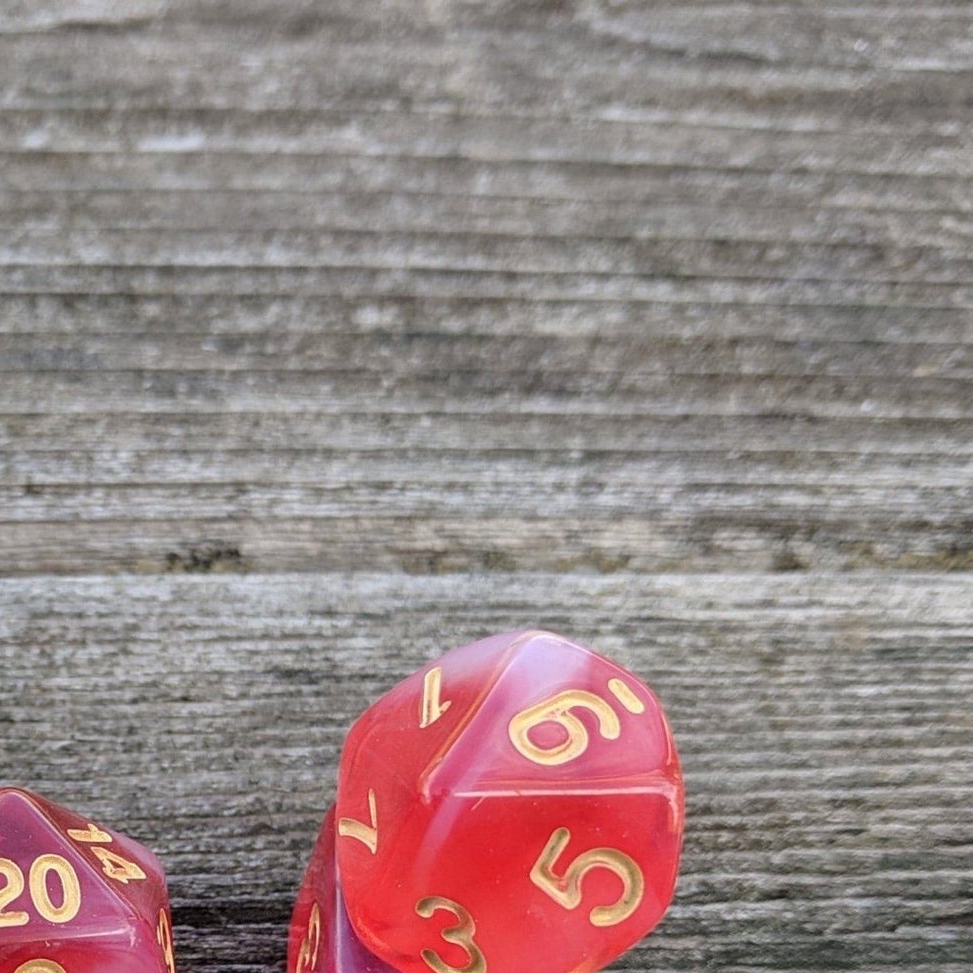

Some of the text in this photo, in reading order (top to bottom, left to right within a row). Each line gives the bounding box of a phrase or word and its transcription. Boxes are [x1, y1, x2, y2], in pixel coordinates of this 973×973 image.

[419, 667, 451, 728] 1
[67, 823, 147, 884] 14
[338, 788, 378, 855] 7
[530, 827, 644, 927] 5
